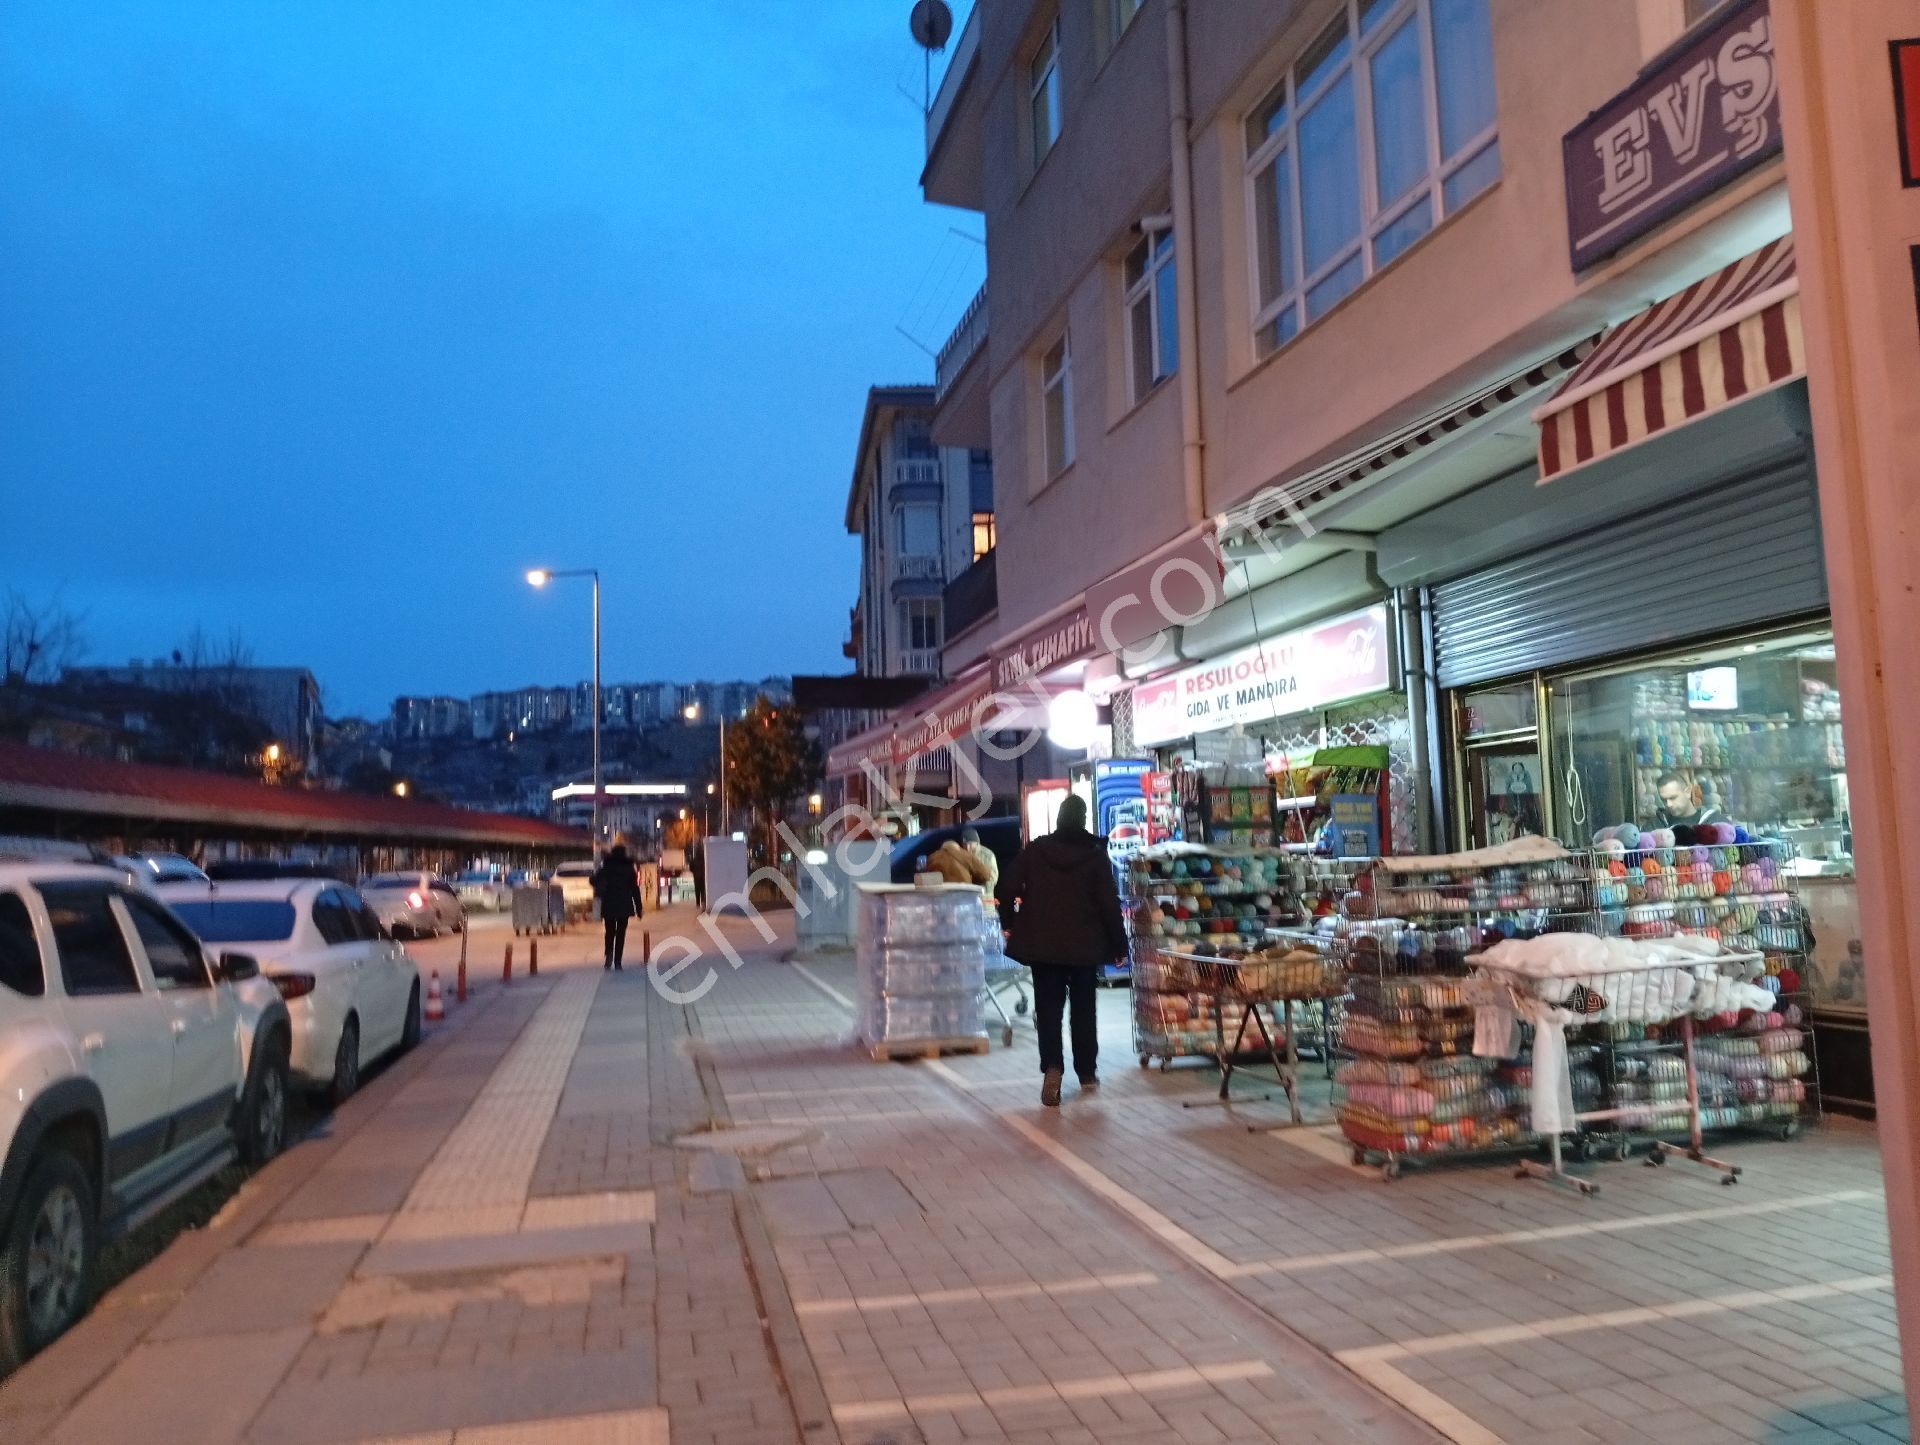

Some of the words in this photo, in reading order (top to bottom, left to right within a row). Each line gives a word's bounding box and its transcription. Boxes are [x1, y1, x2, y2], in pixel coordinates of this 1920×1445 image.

[1032, 613, 1095, 671] TUHAFİY
[1216, 693, 1230, 711] VE
[1236, 675, 1297, 706] MANDIRA
